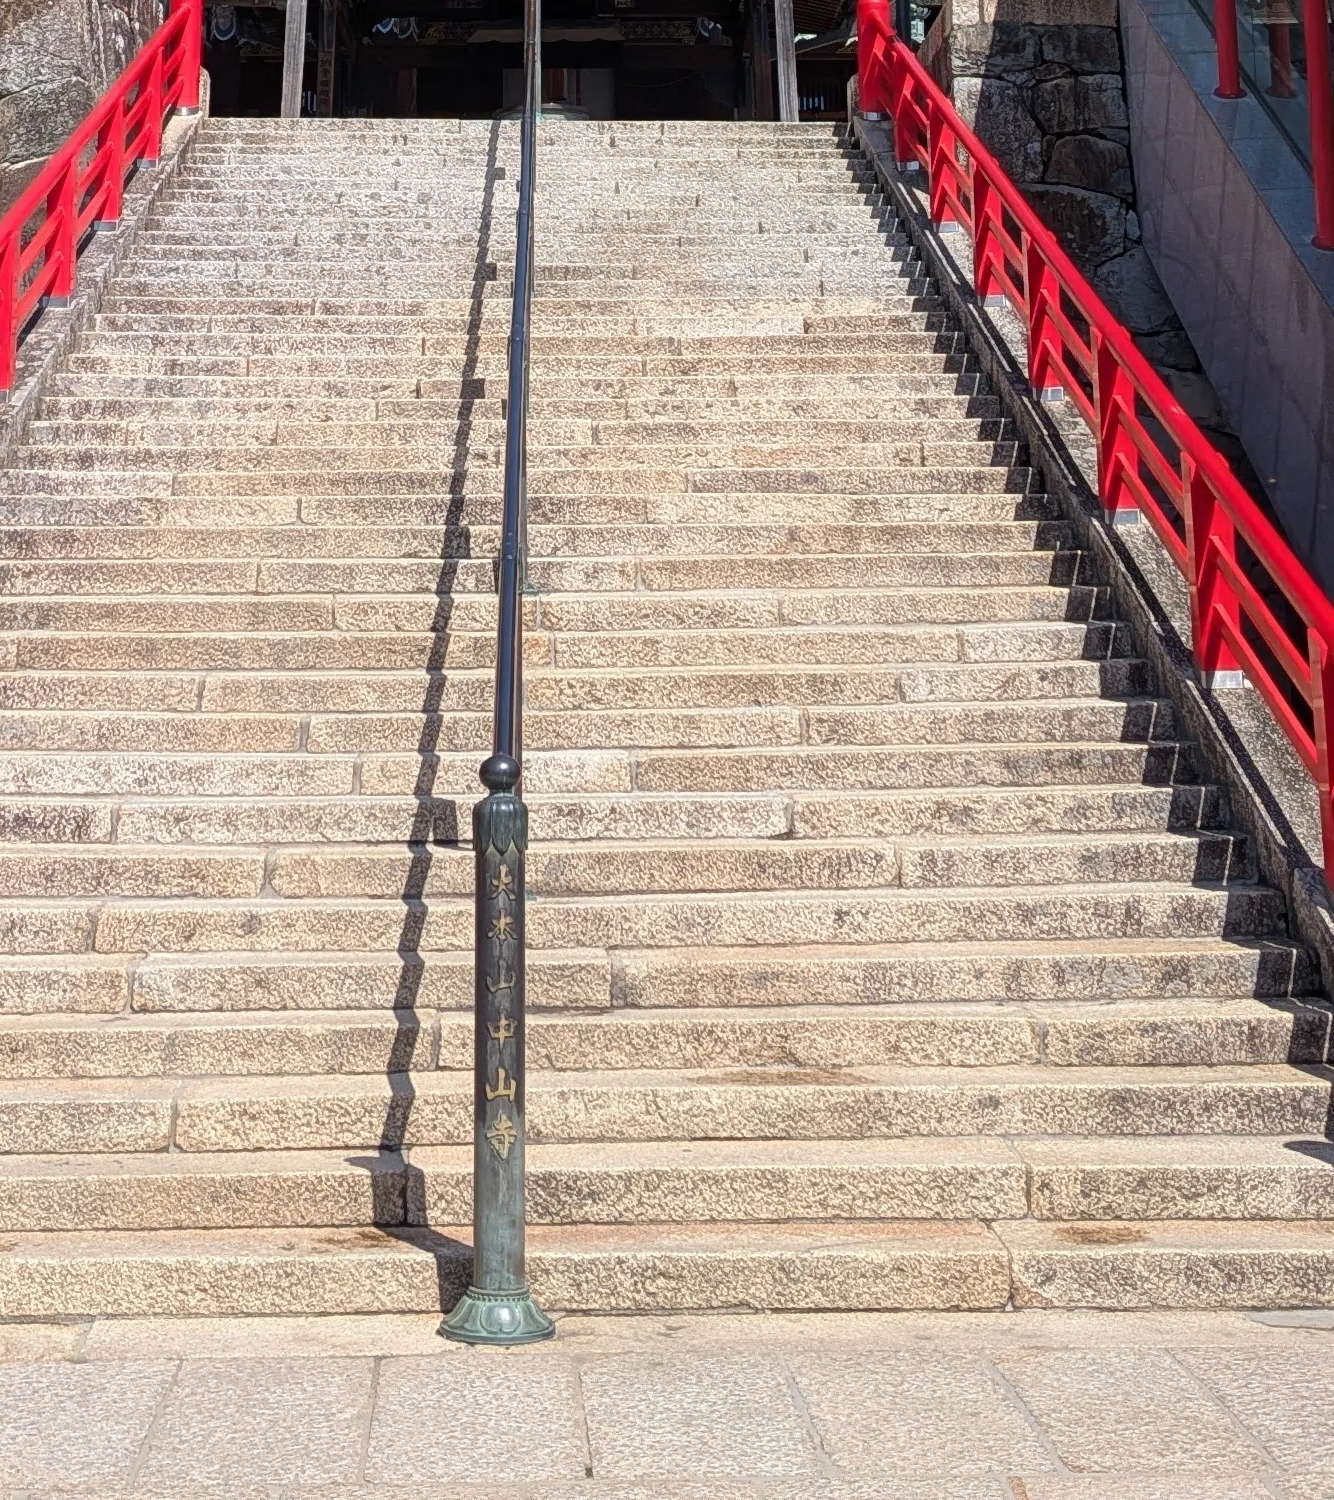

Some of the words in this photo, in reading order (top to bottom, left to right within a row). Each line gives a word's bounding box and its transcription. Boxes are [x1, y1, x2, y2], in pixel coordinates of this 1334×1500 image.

[485, 864, 517, 1161] 大本山中山寺
